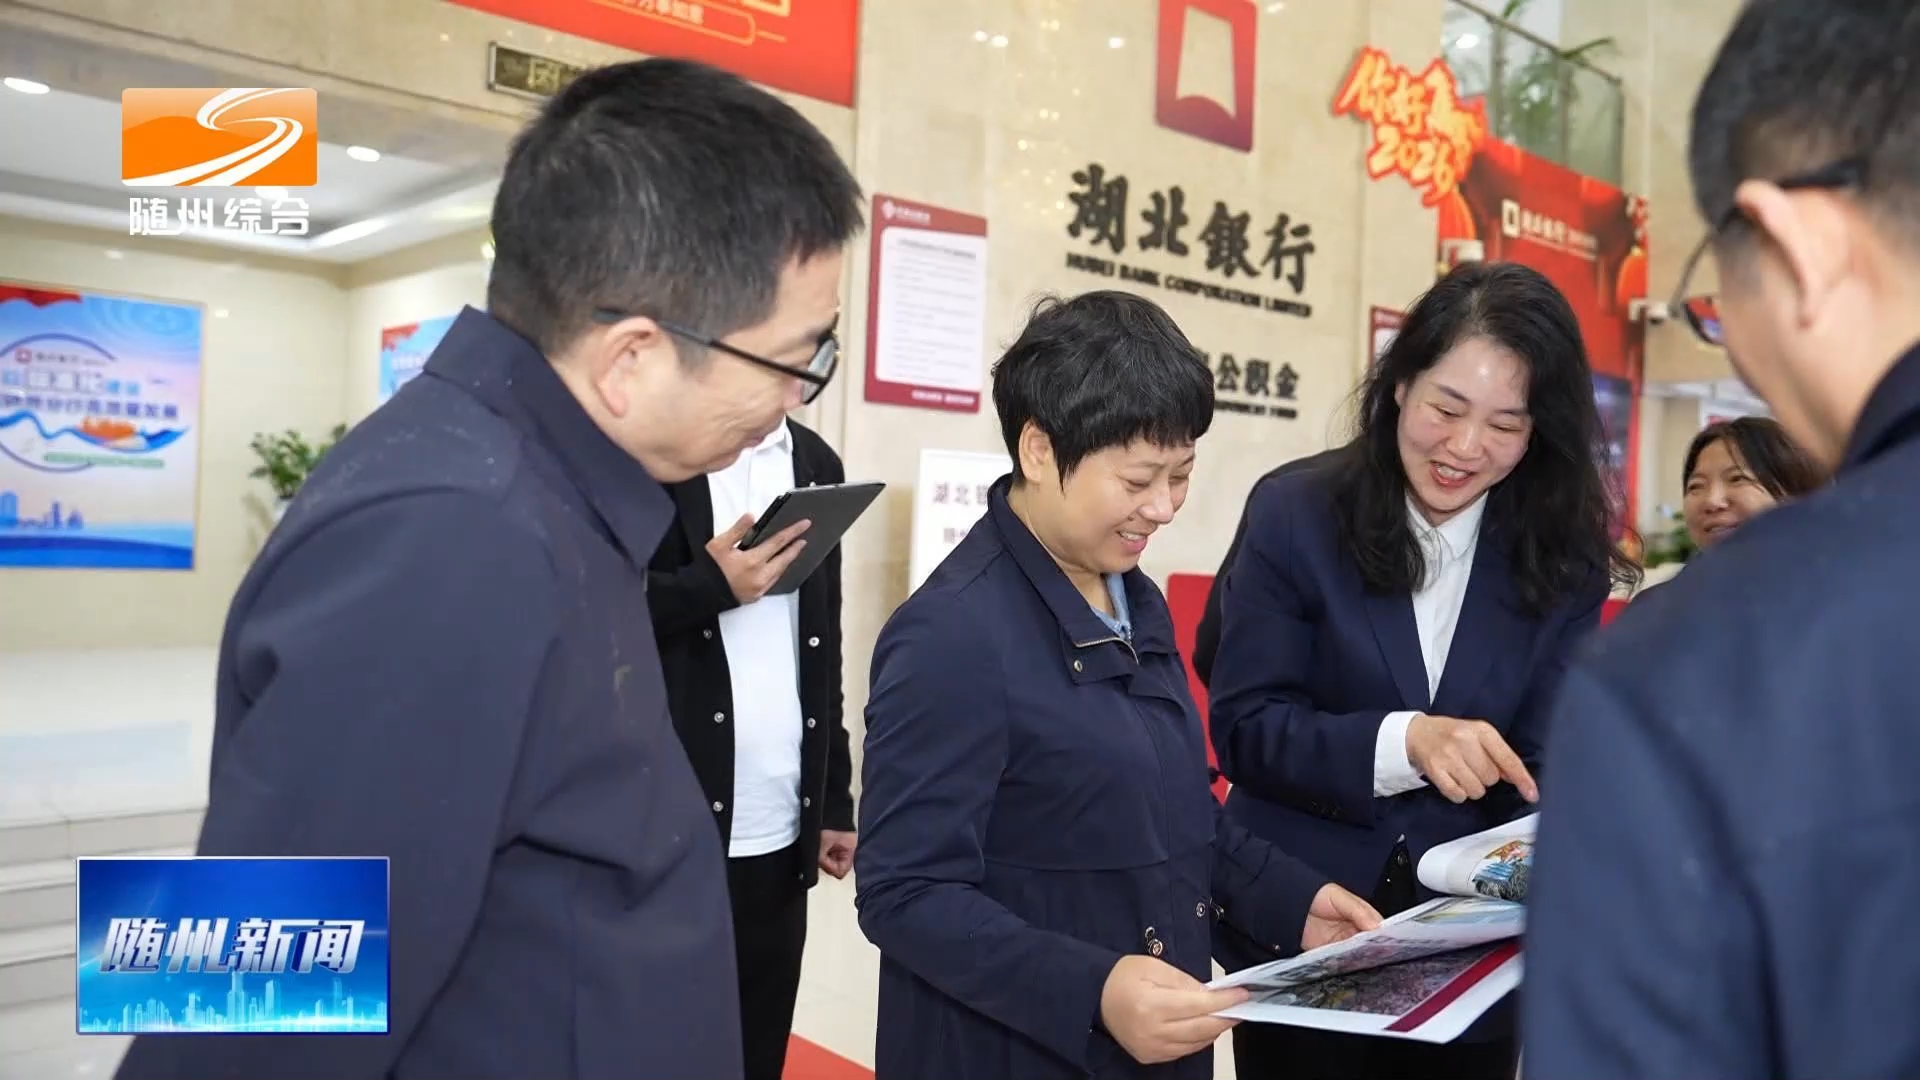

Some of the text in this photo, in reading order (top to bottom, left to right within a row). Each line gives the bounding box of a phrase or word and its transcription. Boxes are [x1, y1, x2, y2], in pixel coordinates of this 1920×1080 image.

[1337, 53, 1429, 135] 你好
[1369, 125, 1456, 194] 2026
[1192, 349, 1300, 400] 公积金
